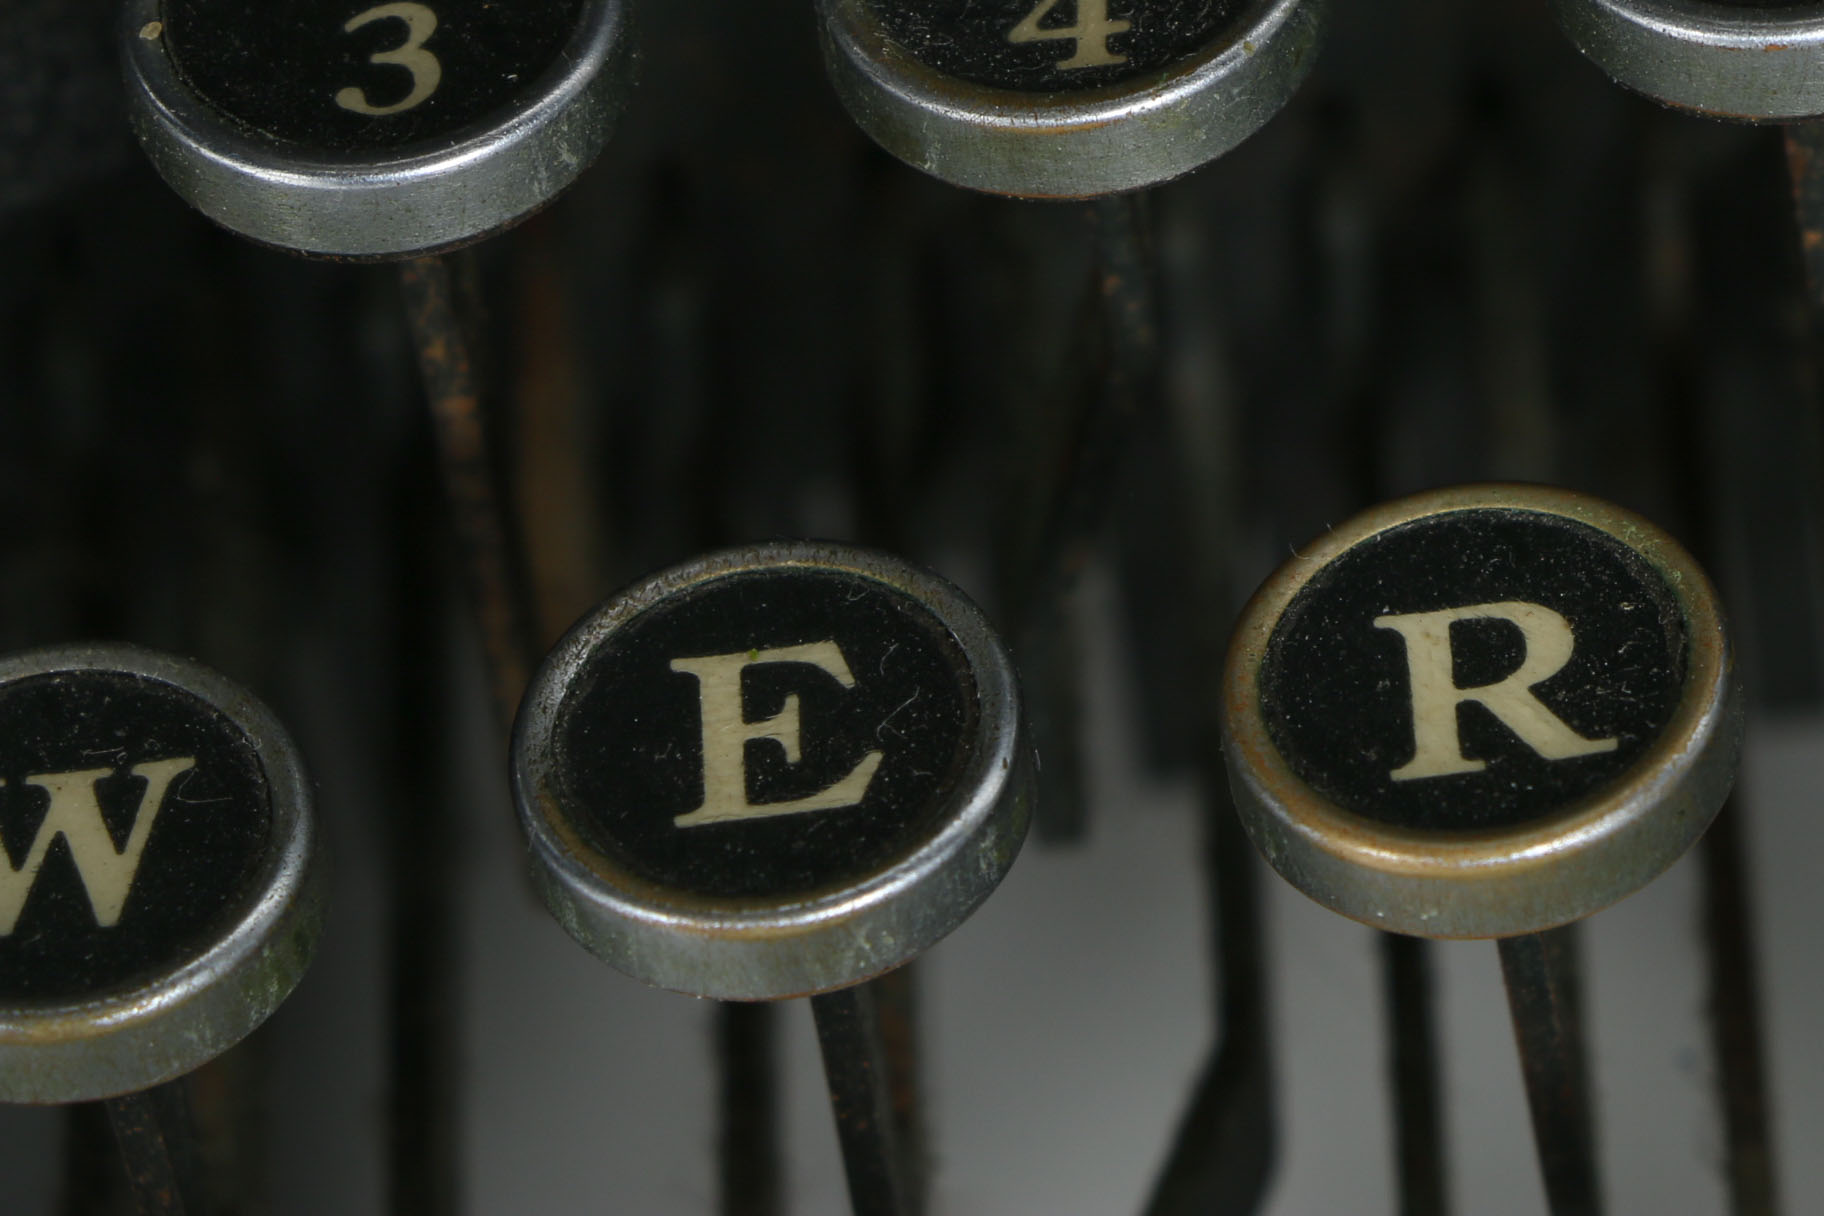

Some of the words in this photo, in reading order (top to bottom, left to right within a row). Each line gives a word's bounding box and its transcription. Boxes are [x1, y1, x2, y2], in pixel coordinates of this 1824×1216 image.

[335, 1, 442, 116] 3
[669, 640, 883, 828] E
[1373, 600, 1617, 781] R
[0, 757, 195, 936] W
